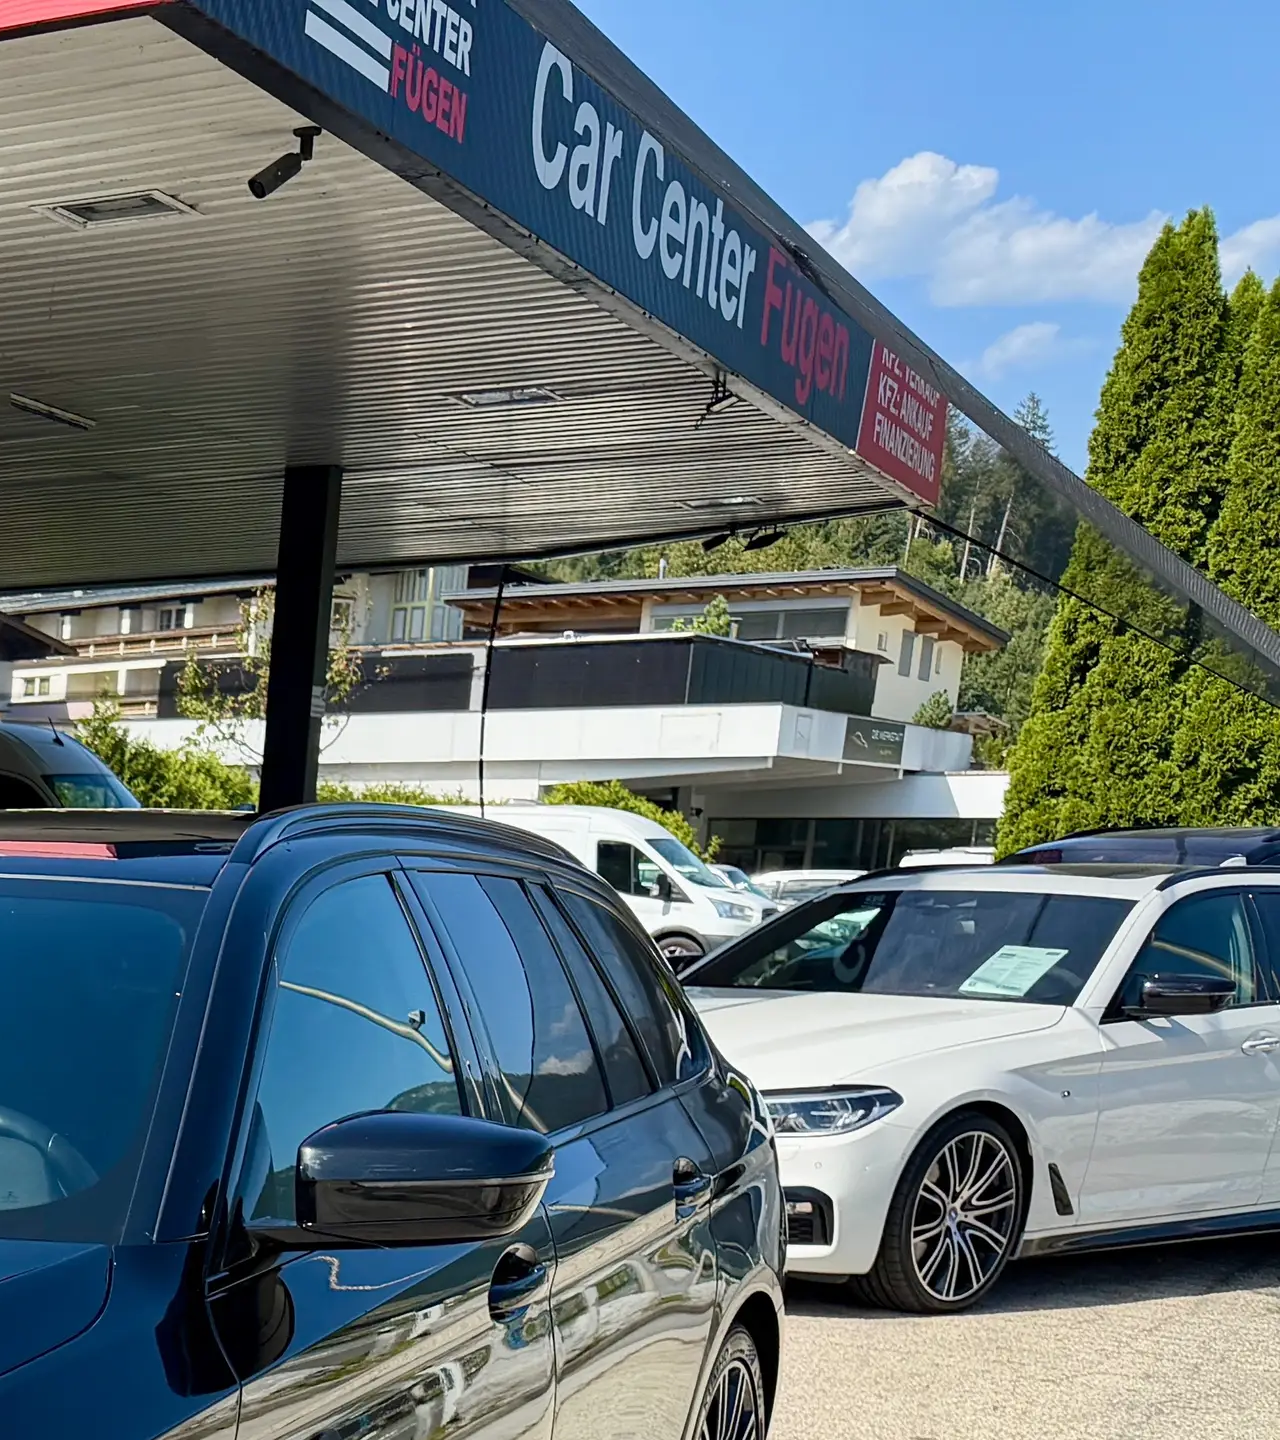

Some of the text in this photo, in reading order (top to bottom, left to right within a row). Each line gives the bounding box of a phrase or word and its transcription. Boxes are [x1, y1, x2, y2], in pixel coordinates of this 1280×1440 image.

[390, 42, 468, 145] FÜGEN
[531, 39, 624, 227] Car
[631, 129, 757, 330] Center
[873, 411, 936, 483] FINANZIERUNG
[899, 391, 934, 442] ANKAUF
